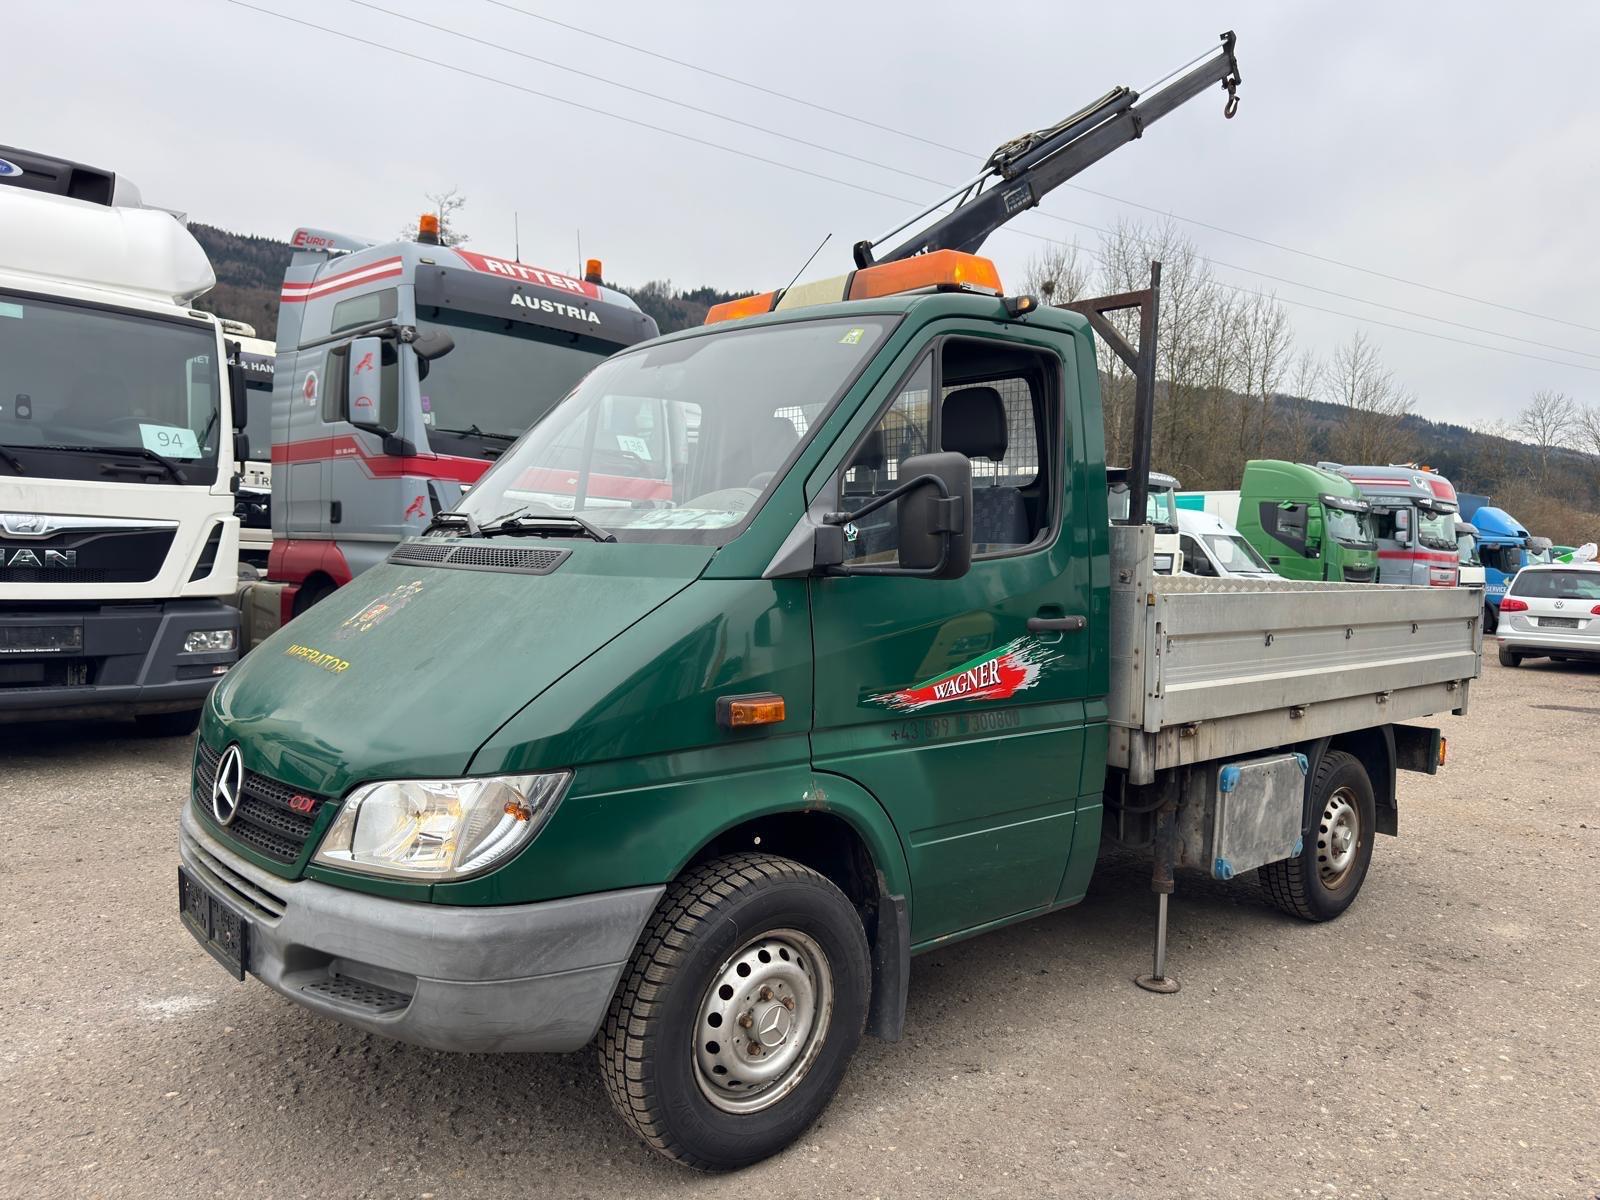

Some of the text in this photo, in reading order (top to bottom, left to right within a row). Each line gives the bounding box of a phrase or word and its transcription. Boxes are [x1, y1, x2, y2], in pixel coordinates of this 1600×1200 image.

[483, 258, 585, 293] RITTER
[510, 293, 601, 324] AUSTRIA
[157, 431, 185, 448] 94
[0, 548, 76, 568] AN
[284, 644, 351, 673] IMPERATOR
[933, 658, 1002, 700] WAGNER
[289, 795, 315, 812] CDI
